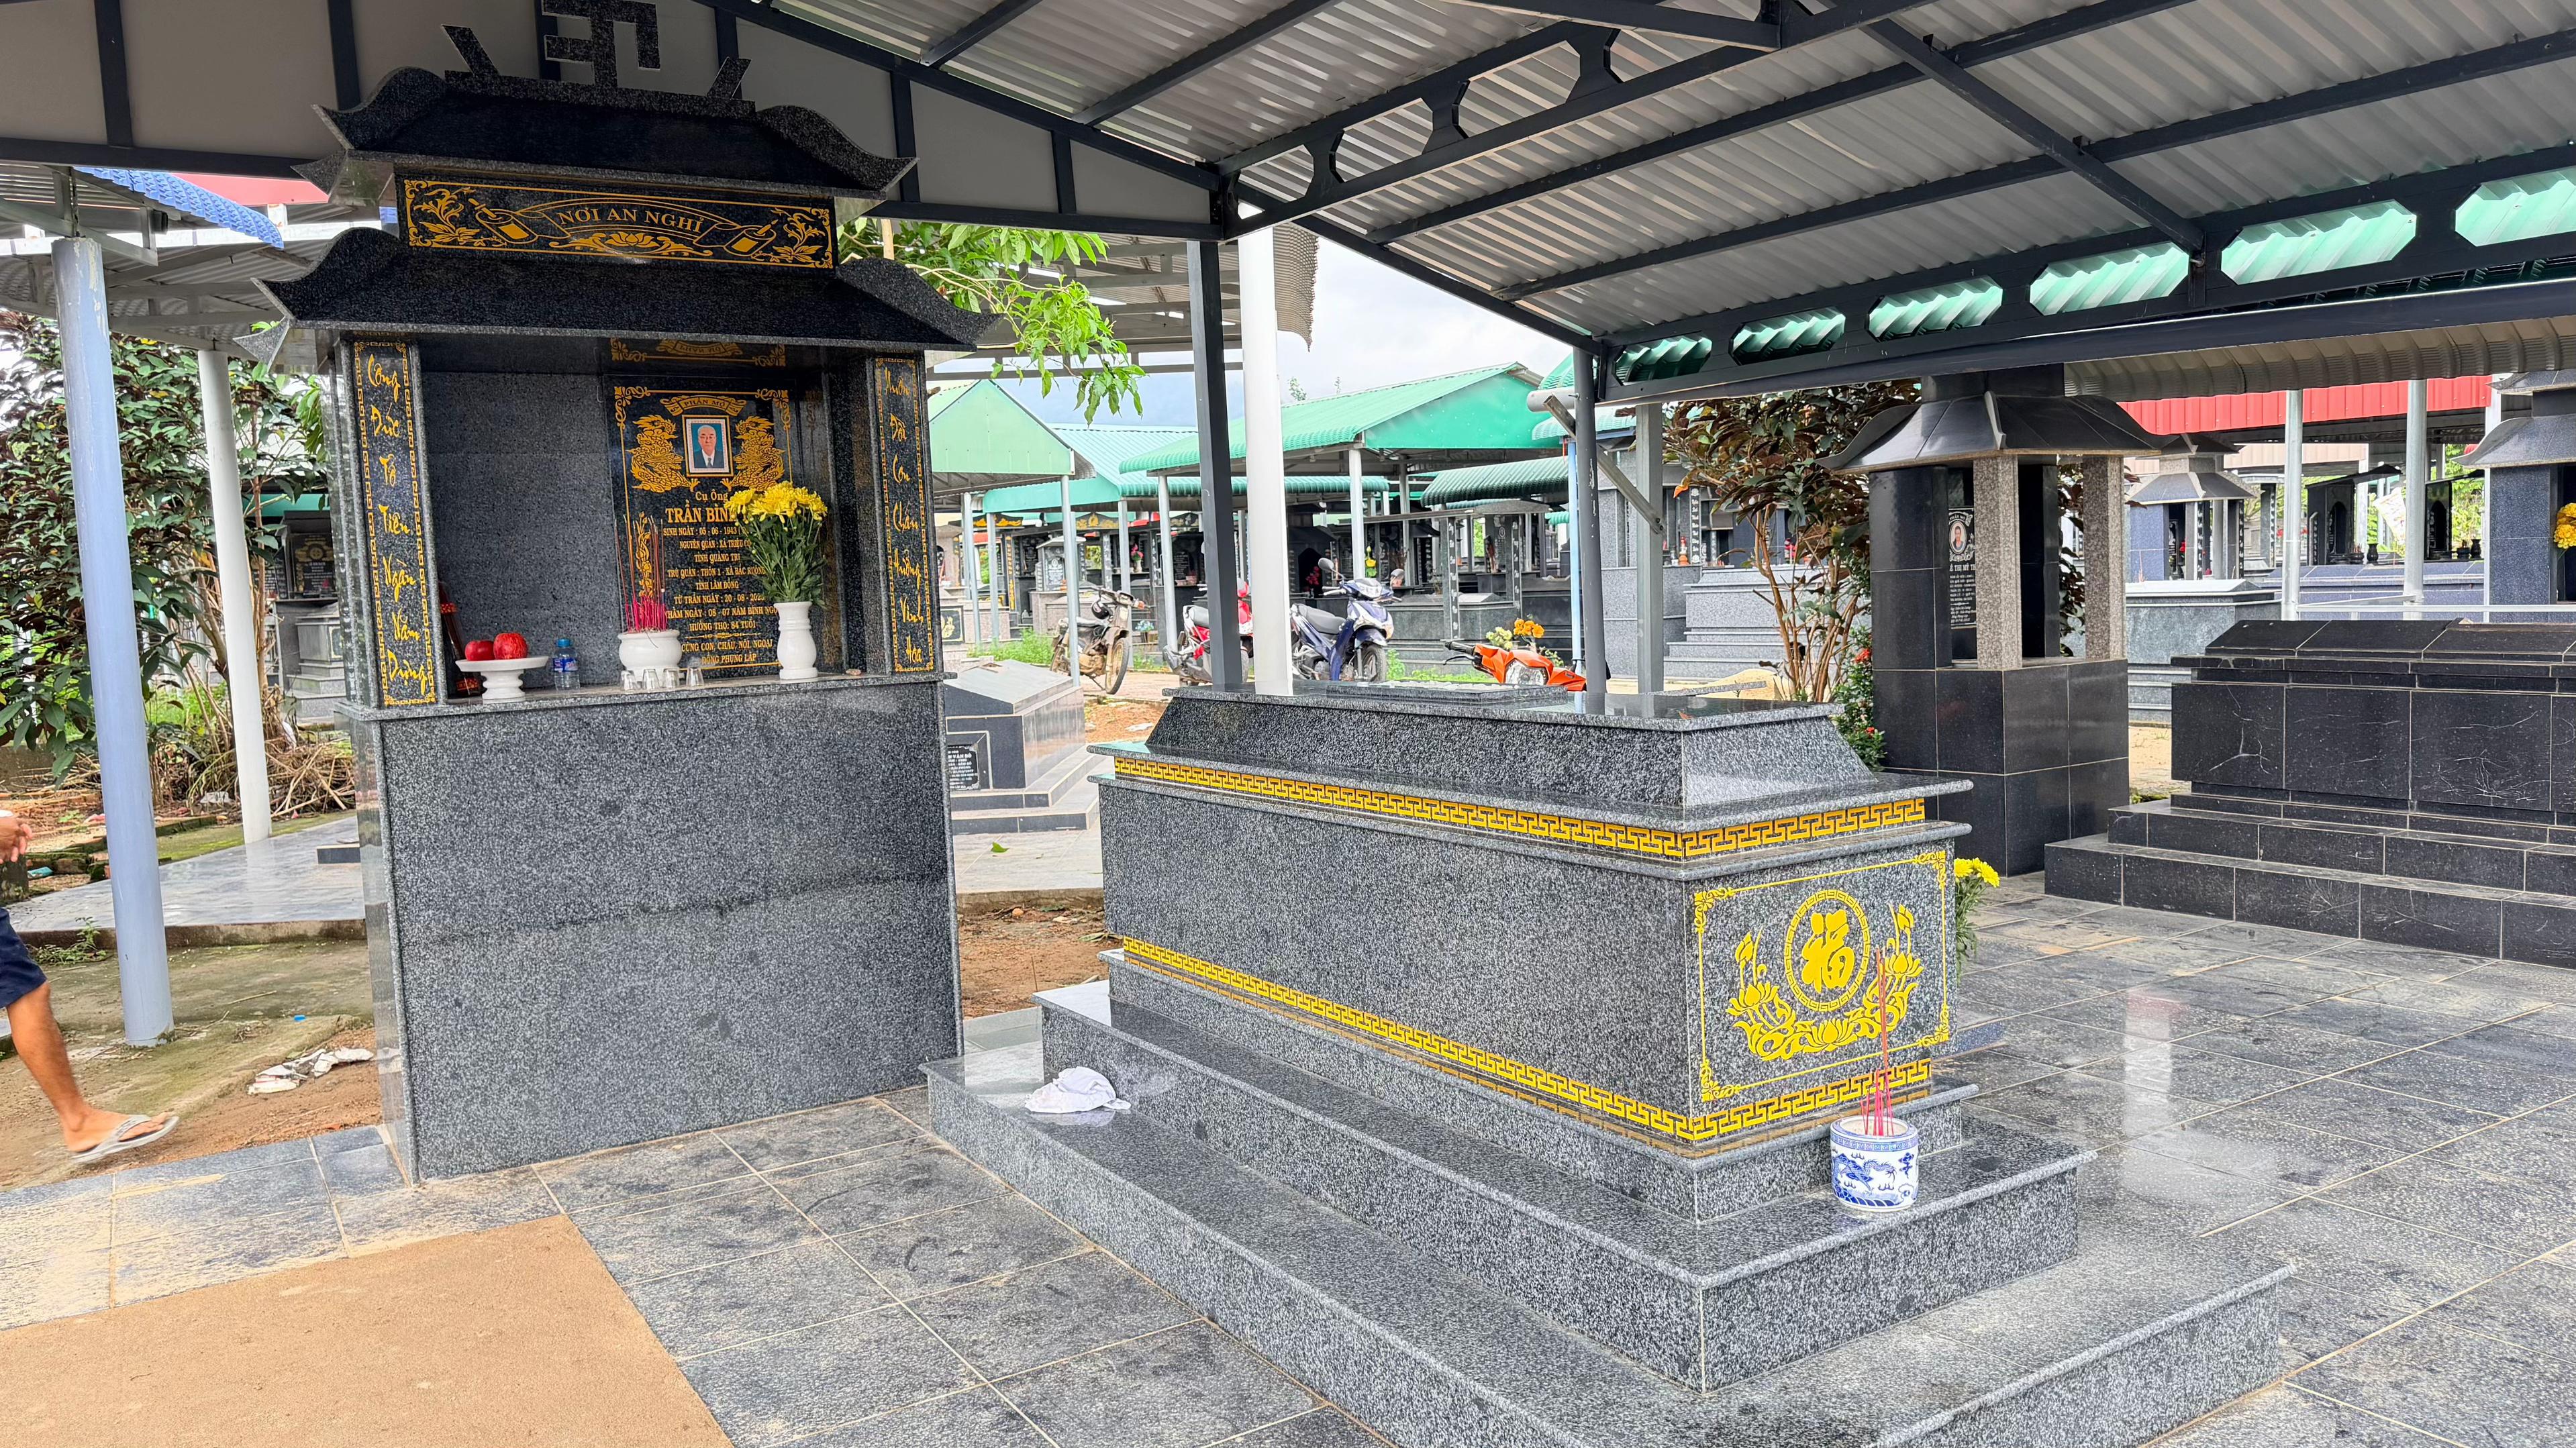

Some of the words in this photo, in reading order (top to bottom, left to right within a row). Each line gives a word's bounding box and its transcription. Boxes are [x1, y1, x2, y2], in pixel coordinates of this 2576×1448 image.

[557, 207, 601, 225] NƠI
[607, 208, 637, 222] AN
[644, 210, 705, 234] NGHỈ
[370, 403, 401, 437] Đức
[893, 454, 910, 484] Con
[695, 491, 708, 502] Cụ
[711, 489, 728, 502] Ông
[378, 504, 410, 535] Tiên
[665, 499, 701, 523] TRẦN
[663, 528, 677, 536] SINH
[678, 525, 695, 536] NGÀY
[703, 592, 720, 603] NGÀY
[725, 594, 732, 603] 20
[685, 607, 702, 617] NGÀY
[731, 621, 739, 629] 84
[1801, 909, 1856, 993] 福
